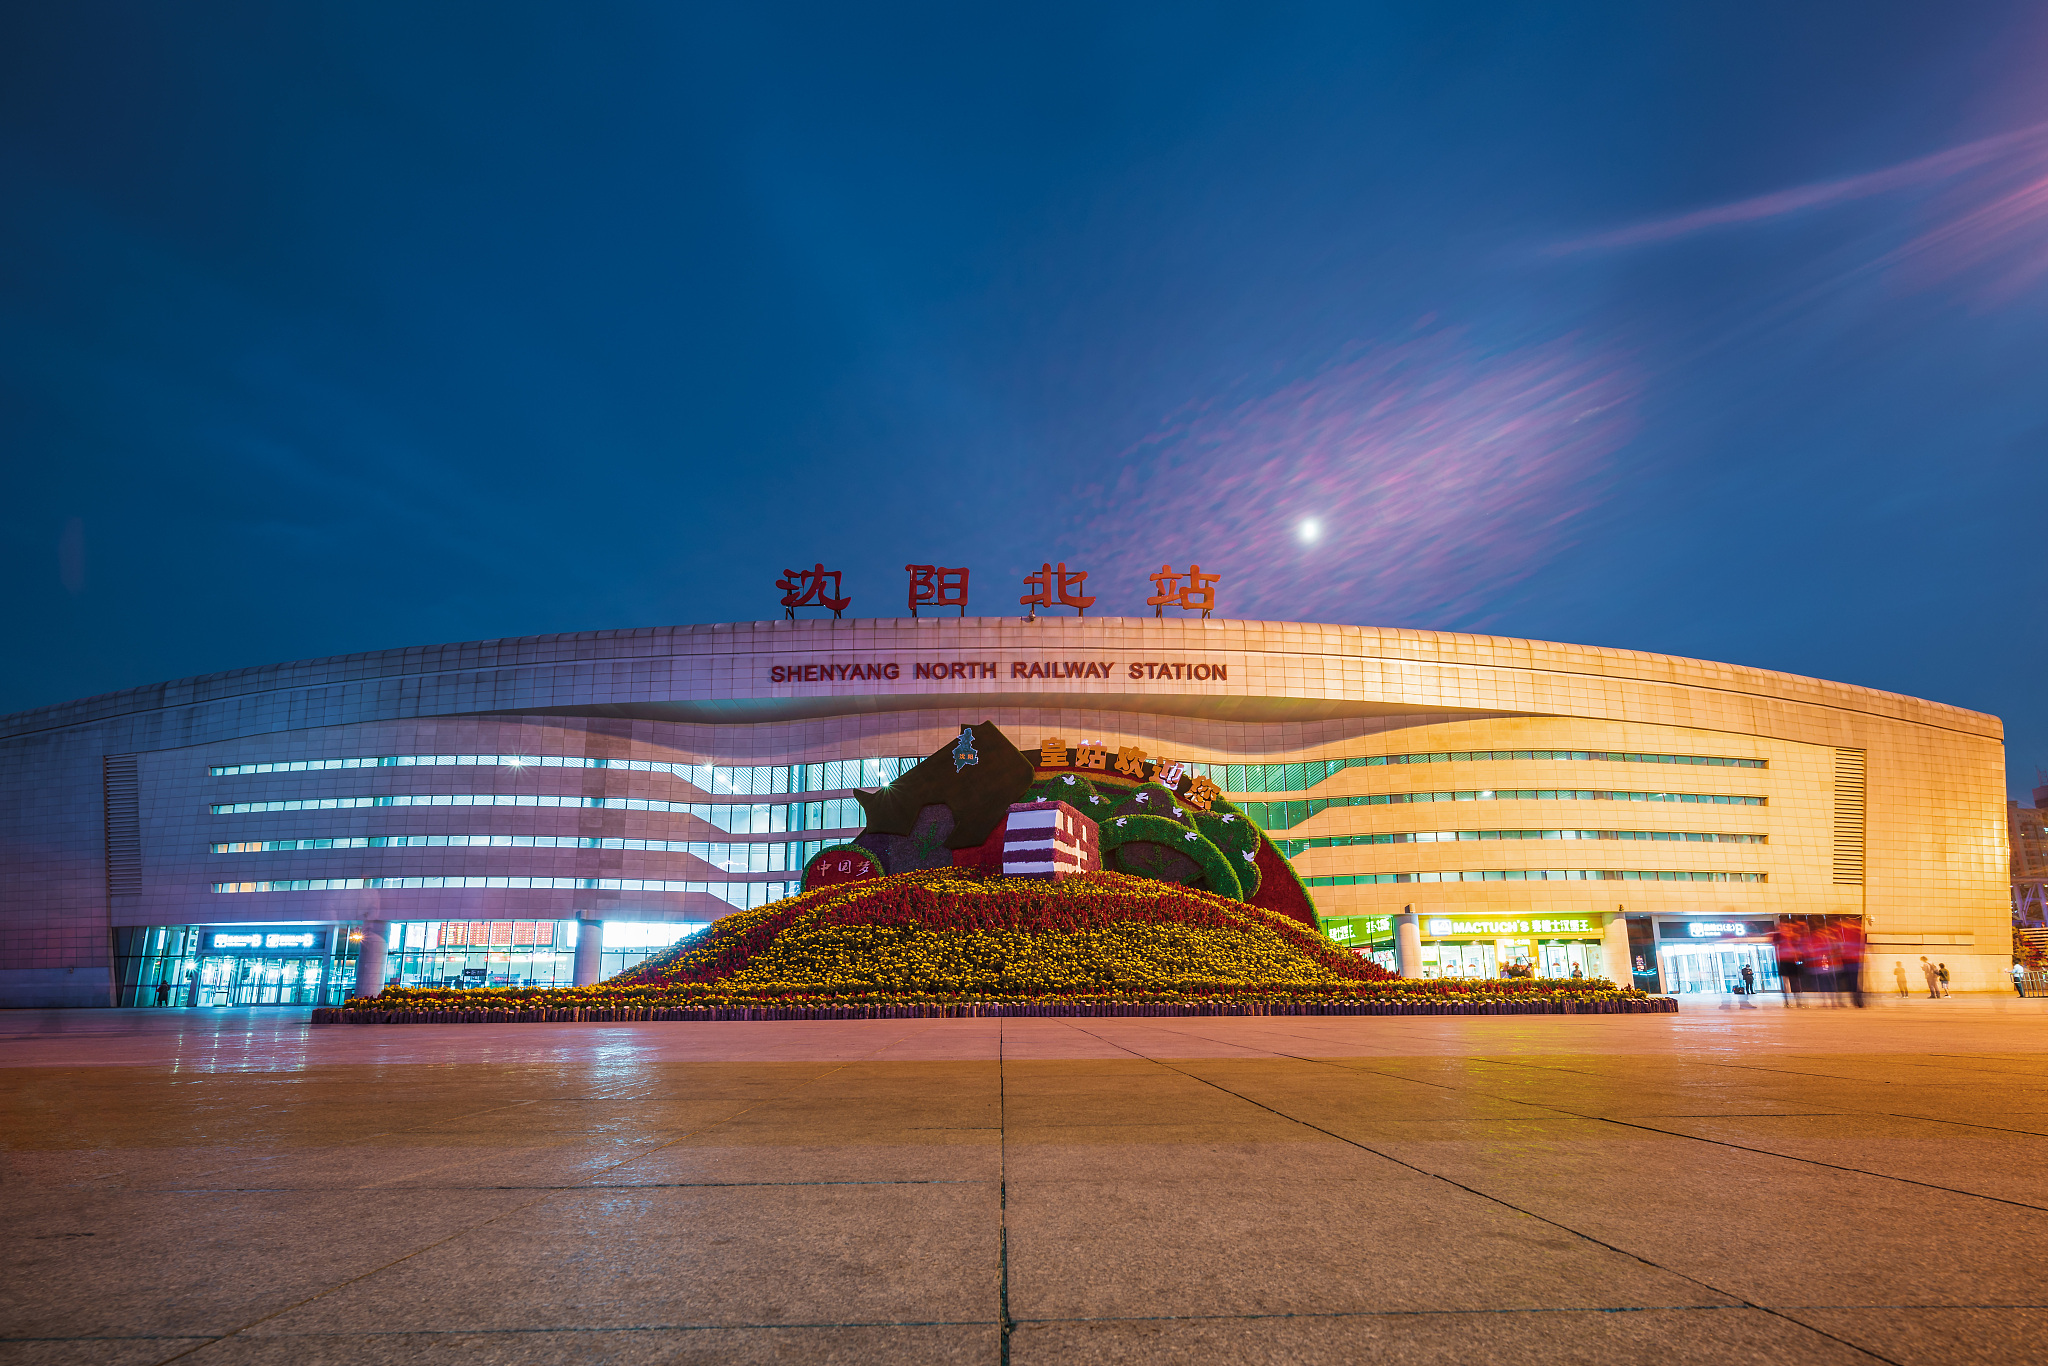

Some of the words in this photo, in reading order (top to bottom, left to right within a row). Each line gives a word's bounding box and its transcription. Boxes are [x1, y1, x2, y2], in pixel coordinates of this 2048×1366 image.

[775, 562, 1221, 611] 沈阳北站
[770, 662, 900, 683] SHENYANG
[915, 662, 997, 680] NORTH
[1011, 661, 1115, 680] RAILWAY
[1128, 662, 1228, 682] STATION
[1040, 737, 1222, 811] 皇姑欢迎您
[816, 859, 871, 877] 中国梦
[1452, 919, 1530, 933] MACTUCH'S
